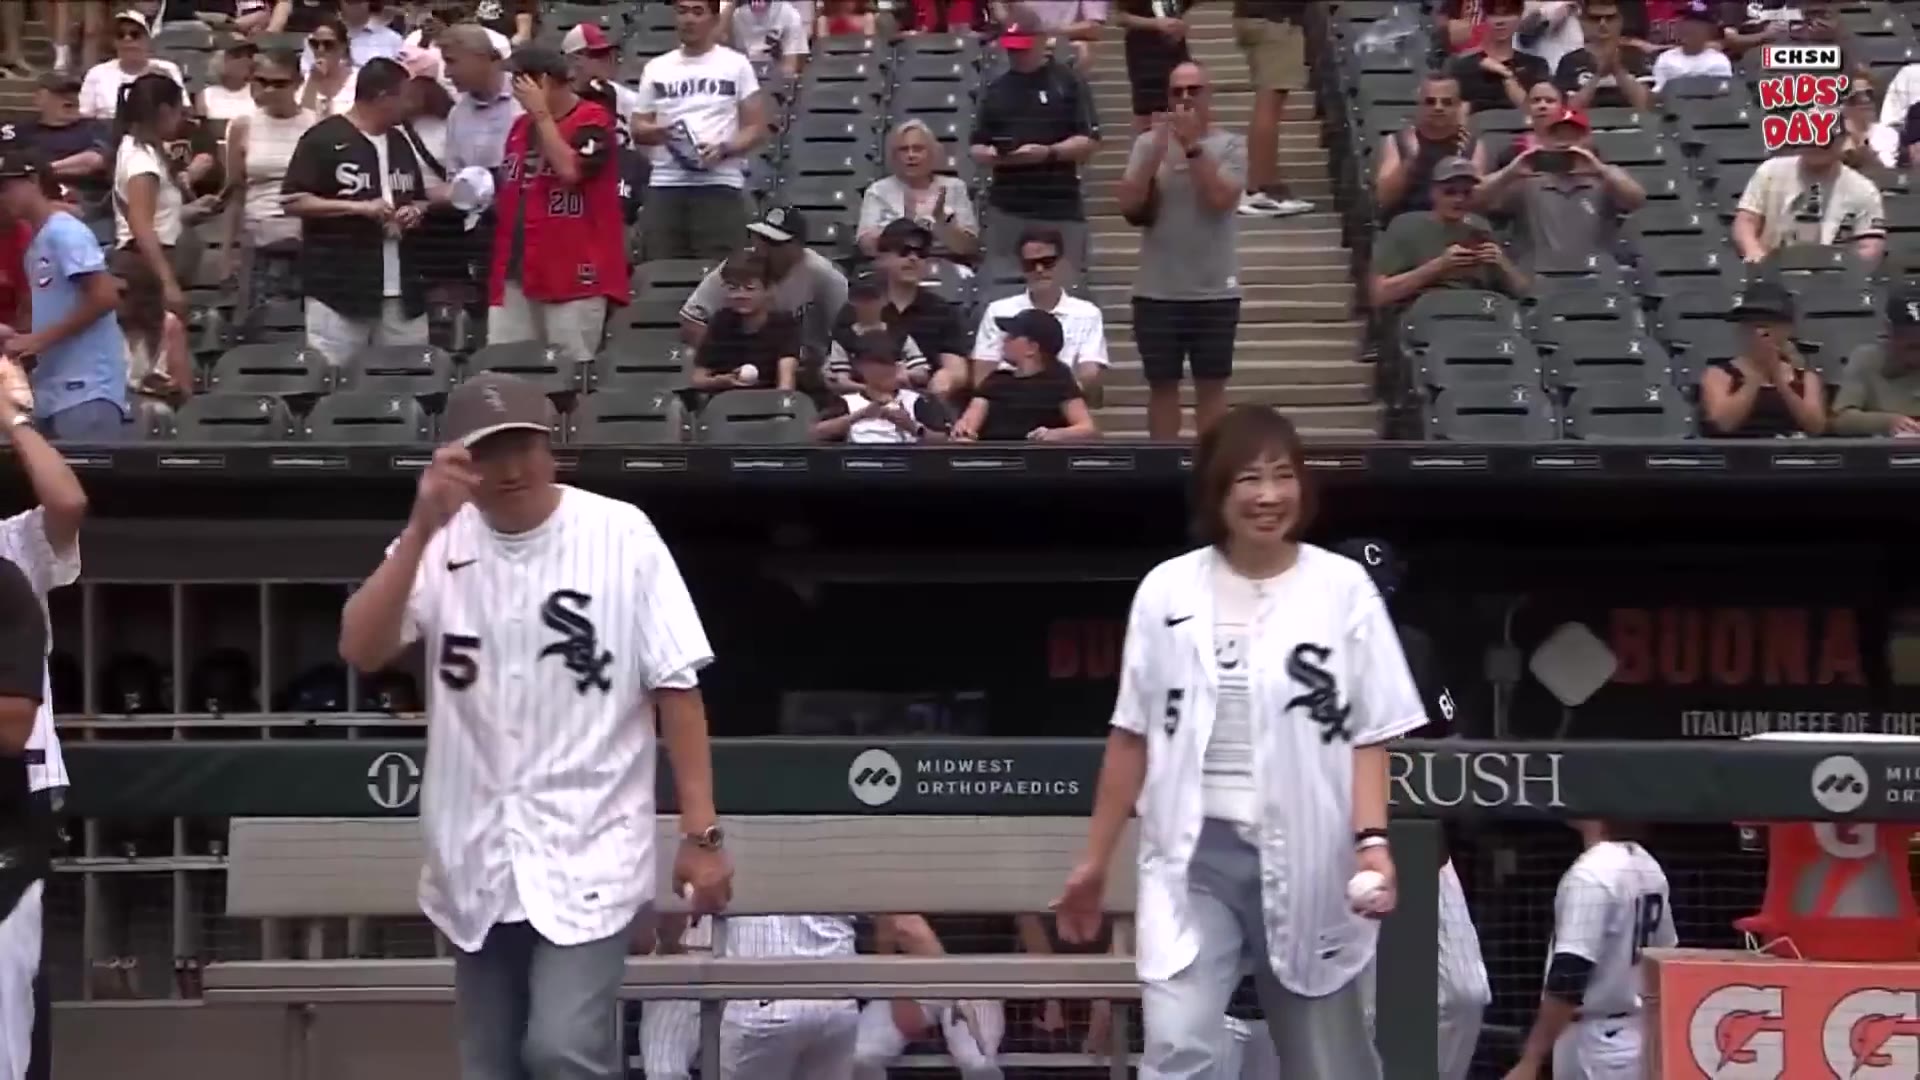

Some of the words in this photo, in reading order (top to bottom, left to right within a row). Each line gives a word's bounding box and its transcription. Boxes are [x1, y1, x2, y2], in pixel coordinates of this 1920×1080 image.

[1364, 546, 1383, 569] C
[439, 634, 482, 691] 5
[1608, 607, 1868, 686] BUONA
[1163, 688, 1185, 738] 5
[1680, 710, 1769, 736] ITALIAN
[1842, 711, 1871, 733] OF
[916, 758, 1015, 774] MIDWEST
[916, 780, 1080, 796] ORTHOPAEDICS
[1387, 752, 1566, 809] RUSH
[1688, 984, 1787, 1080] G
[1822, 986, 1920, 1080] G
